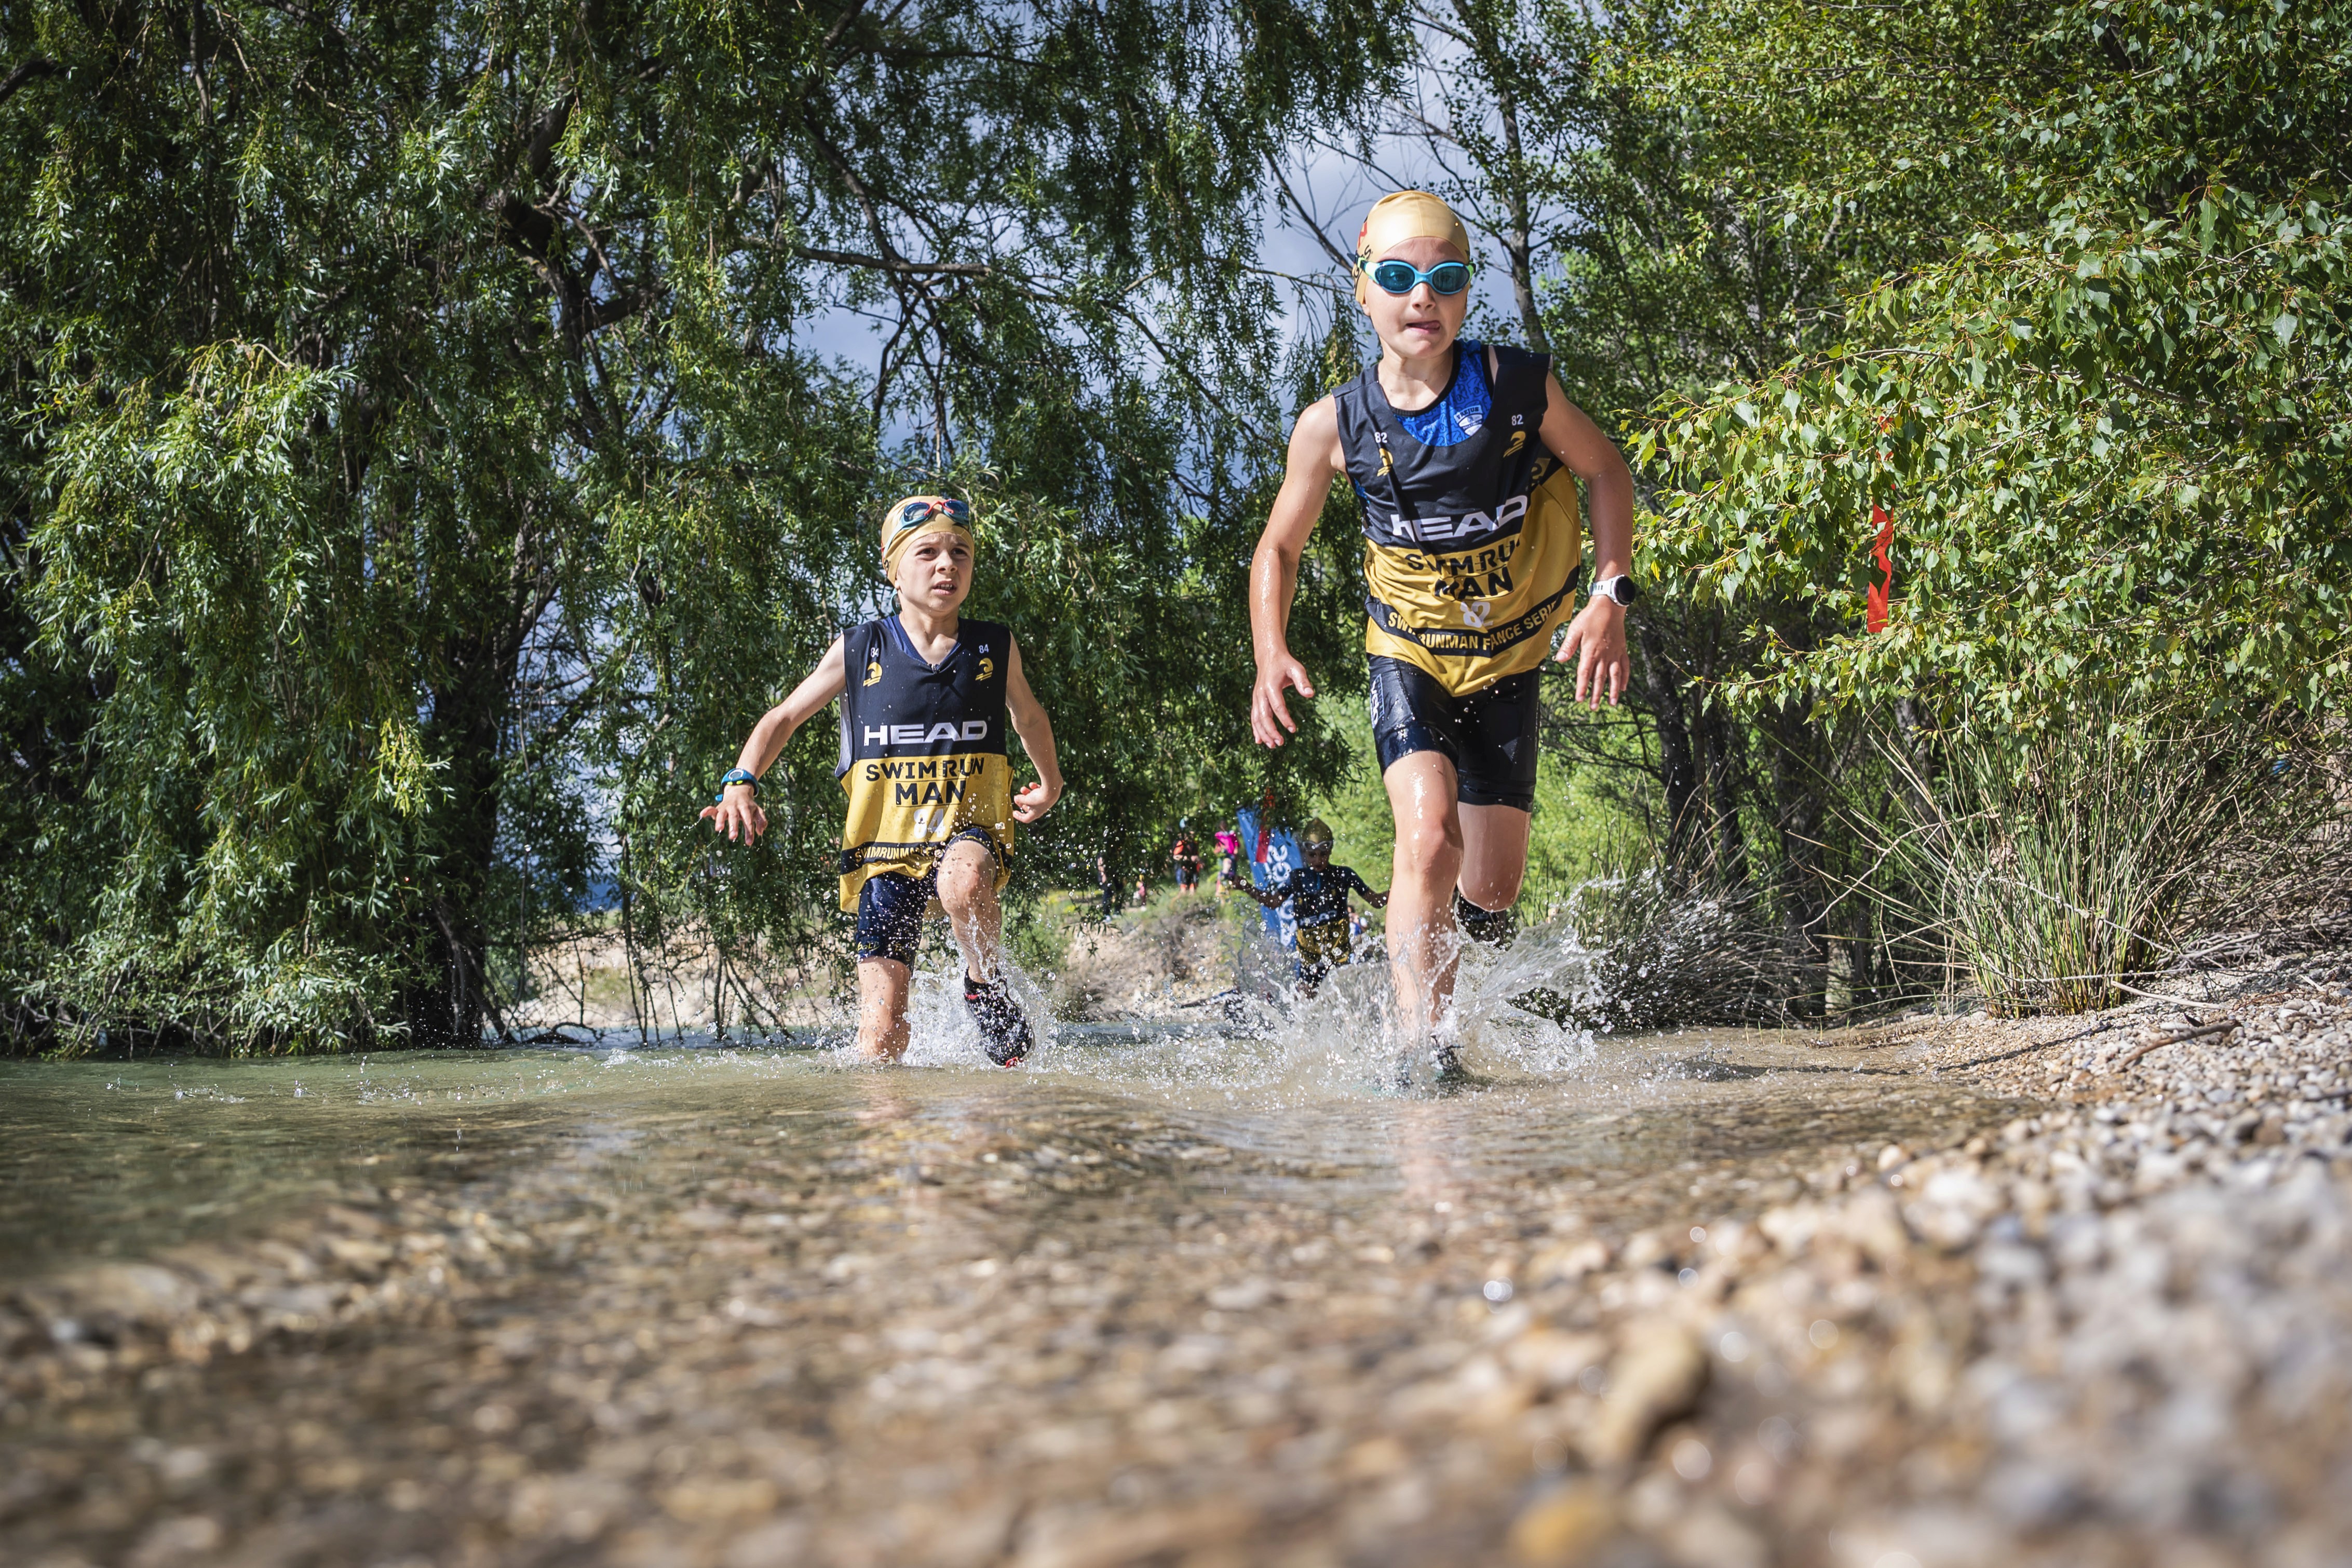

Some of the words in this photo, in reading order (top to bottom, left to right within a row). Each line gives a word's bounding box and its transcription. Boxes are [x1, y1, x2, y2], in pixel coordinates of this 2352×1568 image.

[1511, 414, 1524, 426] 82
[1374, 431, 1388, 443] 82
[1390, 495, 1528, 543] HEAD
[1460, 601, 1494, 628] 82
[1388, 612, 1478, 649] SWRUNMAN
[870, 647, 879, 658] 84
[979, 644, 989, 654] 84
[863, 720, 988, 747] HEAD
[866, 757, 984, 781] SWIMRUN
[896, 780, 966, 805] MAN
[913, 808, 946, 839] 84
